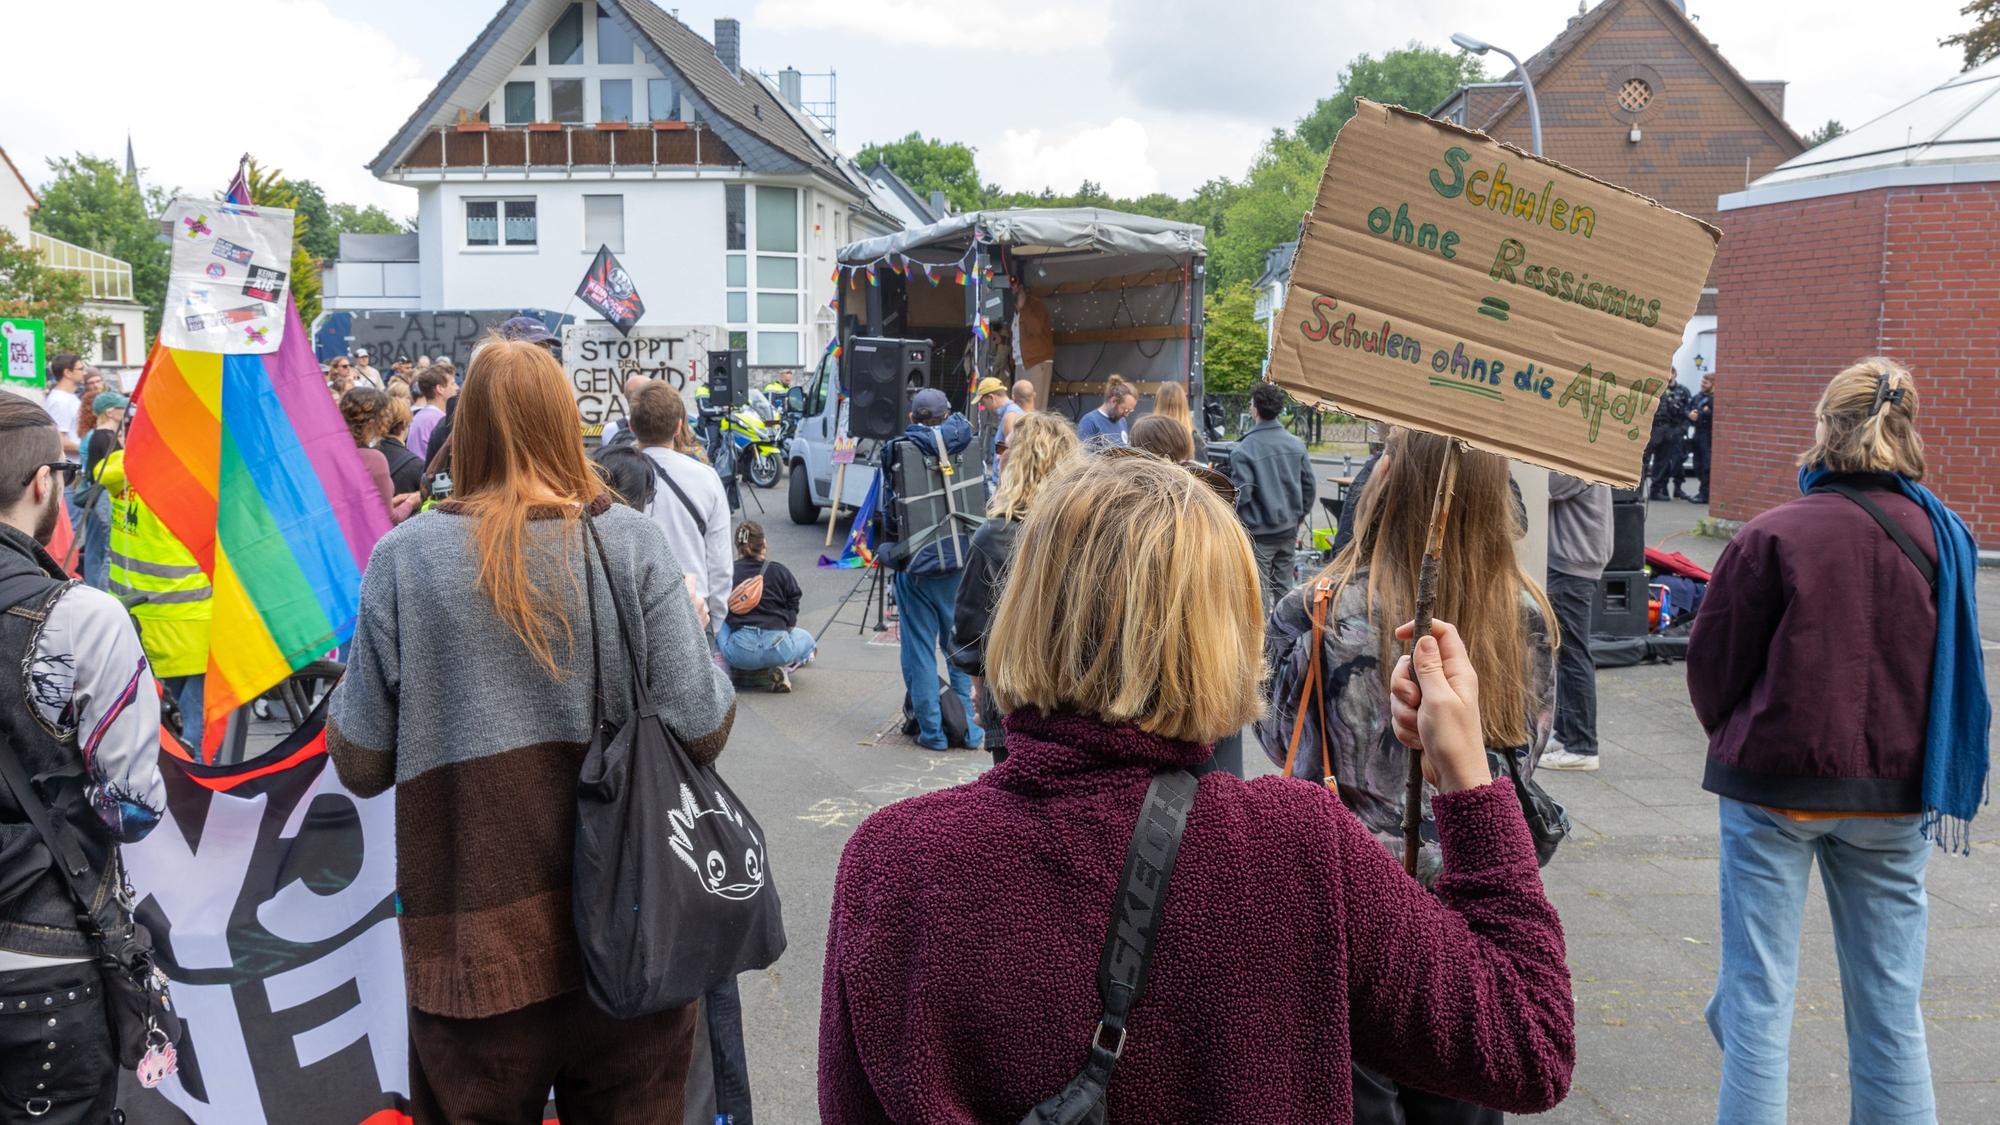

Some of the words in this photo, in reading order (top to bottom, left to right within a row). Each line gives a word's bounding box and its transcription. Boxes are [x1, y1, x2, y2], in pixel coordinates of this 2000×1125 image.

[1429, 146, 1597, 239] Schulen
[1367, 202, 1461, 260] ohne
[1489, 238, 1661, 328] Rassismus
[11, 342, 27, 352] FCK
[400, 311, 479, 342] AFD
[580, 338, 685, 362] STOPPT
[1300, 294, 1422, 364] Schulen
[1431, 343, 1505, 386] ohne
[1514, 363, 1555, 401] die
[617, 359, 640, 369] DEN
[1108, 771, 1198, 991] SKECH
